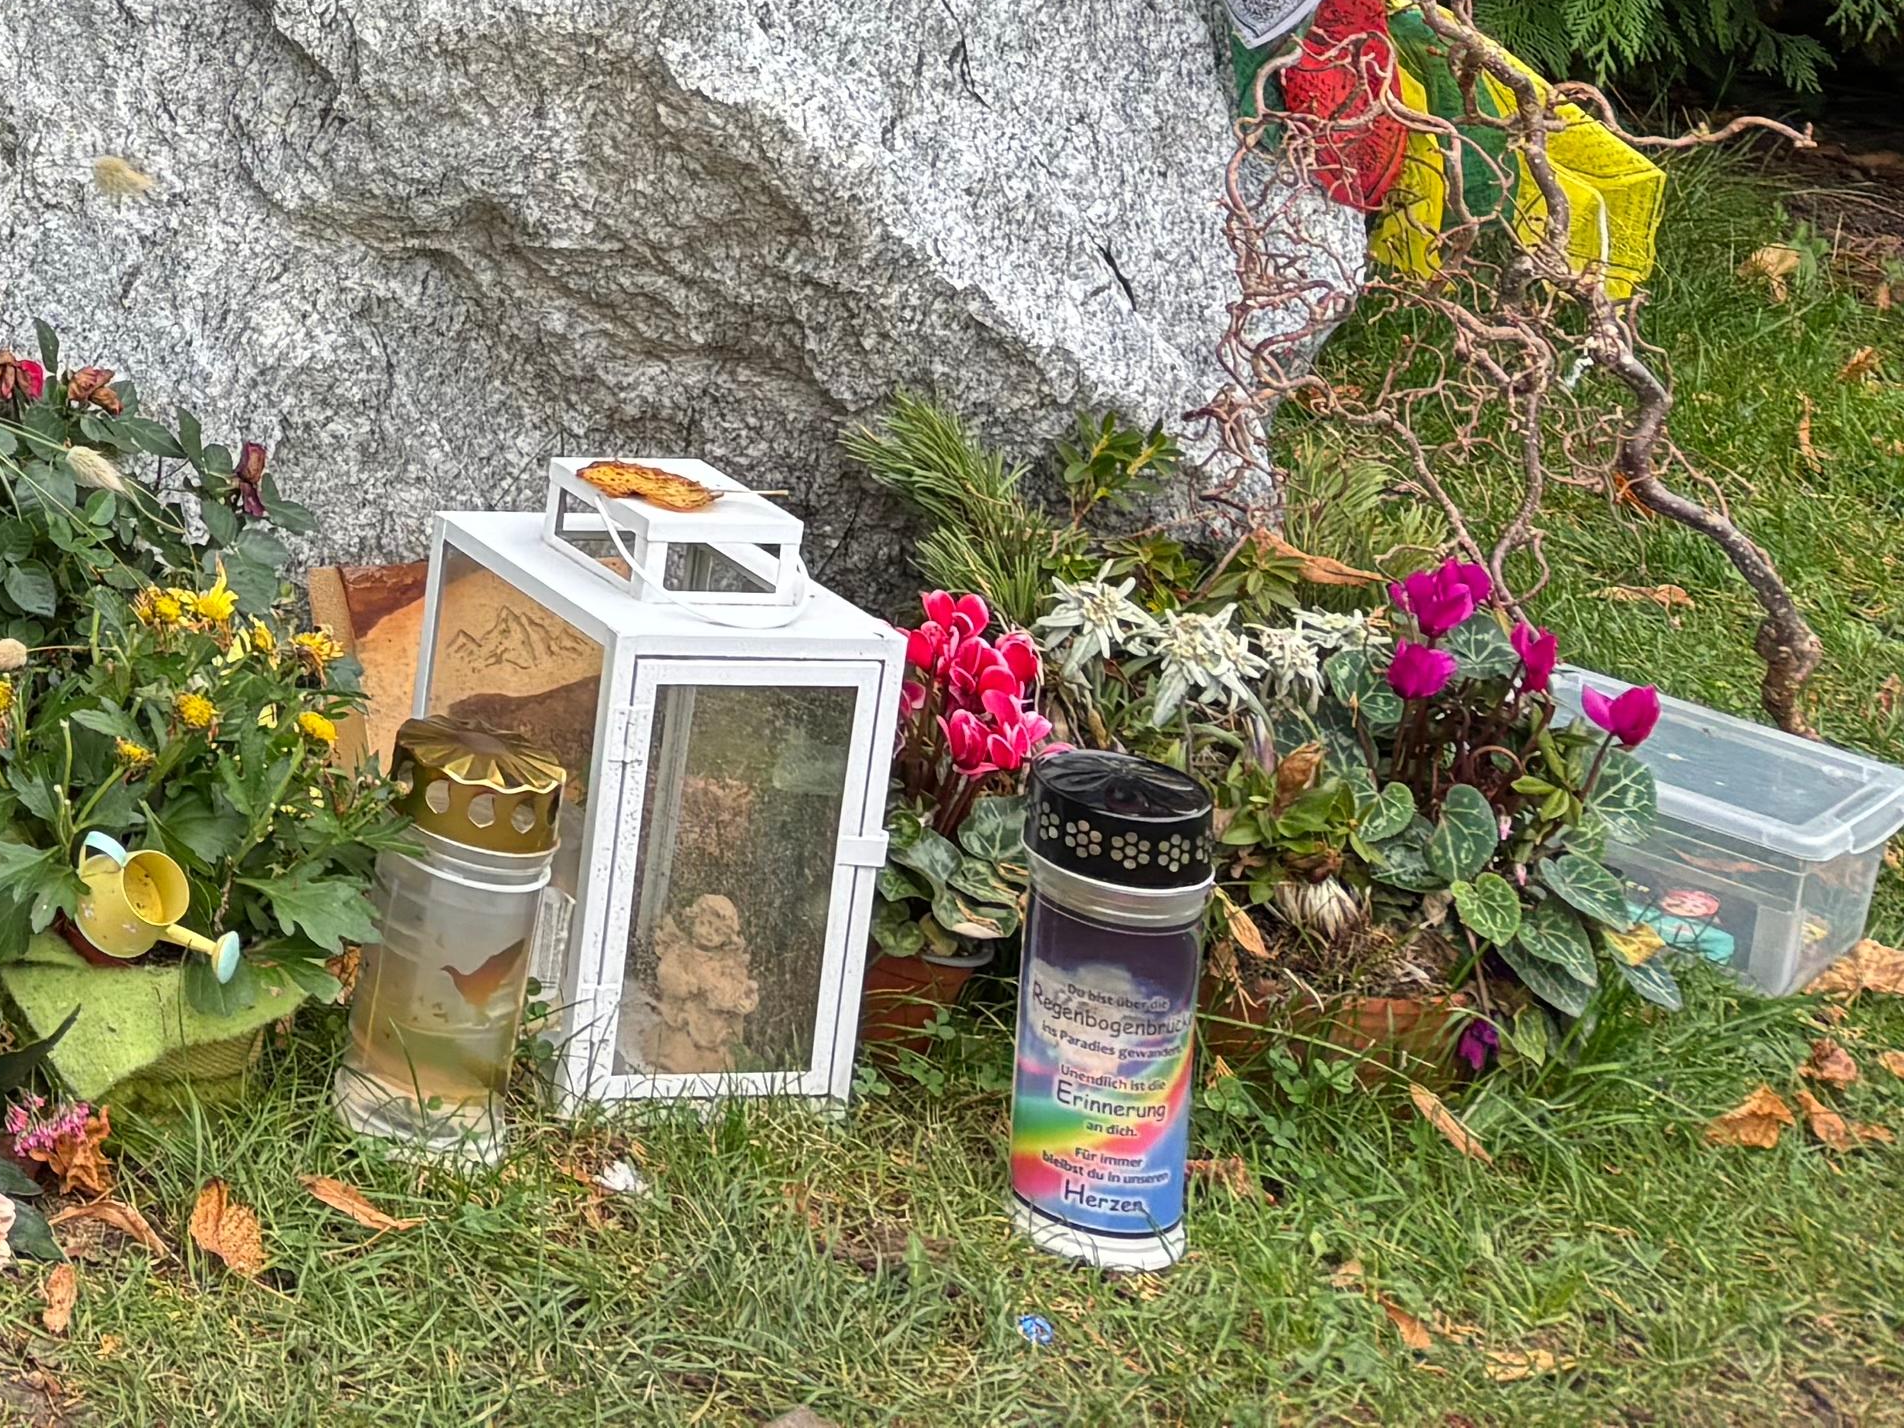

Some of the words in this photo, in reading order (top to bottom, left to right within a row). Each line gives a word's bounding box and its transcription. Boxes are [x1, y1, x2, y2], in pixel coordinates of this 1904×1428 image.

[1067, 983, 1086, 999] Du
[1087, 990, 1114, 1006] bist
[1116, 995, 1148, 1010] über
[1150, 997, 1170, 1013] die
[1041, 1019, 1058, 1039] ins
[1059, 1029, 1116, 1056] Paradies
[1060, 1063, 1128, 1091] Unendlich
[1129, 1079, 1146, 1092] ist
[1147, 1078, 1167, 1092] die
[1055, 1079, 1167, 1122] Erinnerung
[1085, 1120, 1104, 1134] an
[1106, 1123, 1138, 1138] dich.
[1041, 1149, 1085, 1176] bleibst
[1087, 1167, 1106, 1182] du
[1107, 1170, 1122, 1184] in
[1074, 1146, 1098, 1162] Für
[1100, 1154, 1144, 1168] immer
[1063, 1178, 1146, 1213] Herzen
